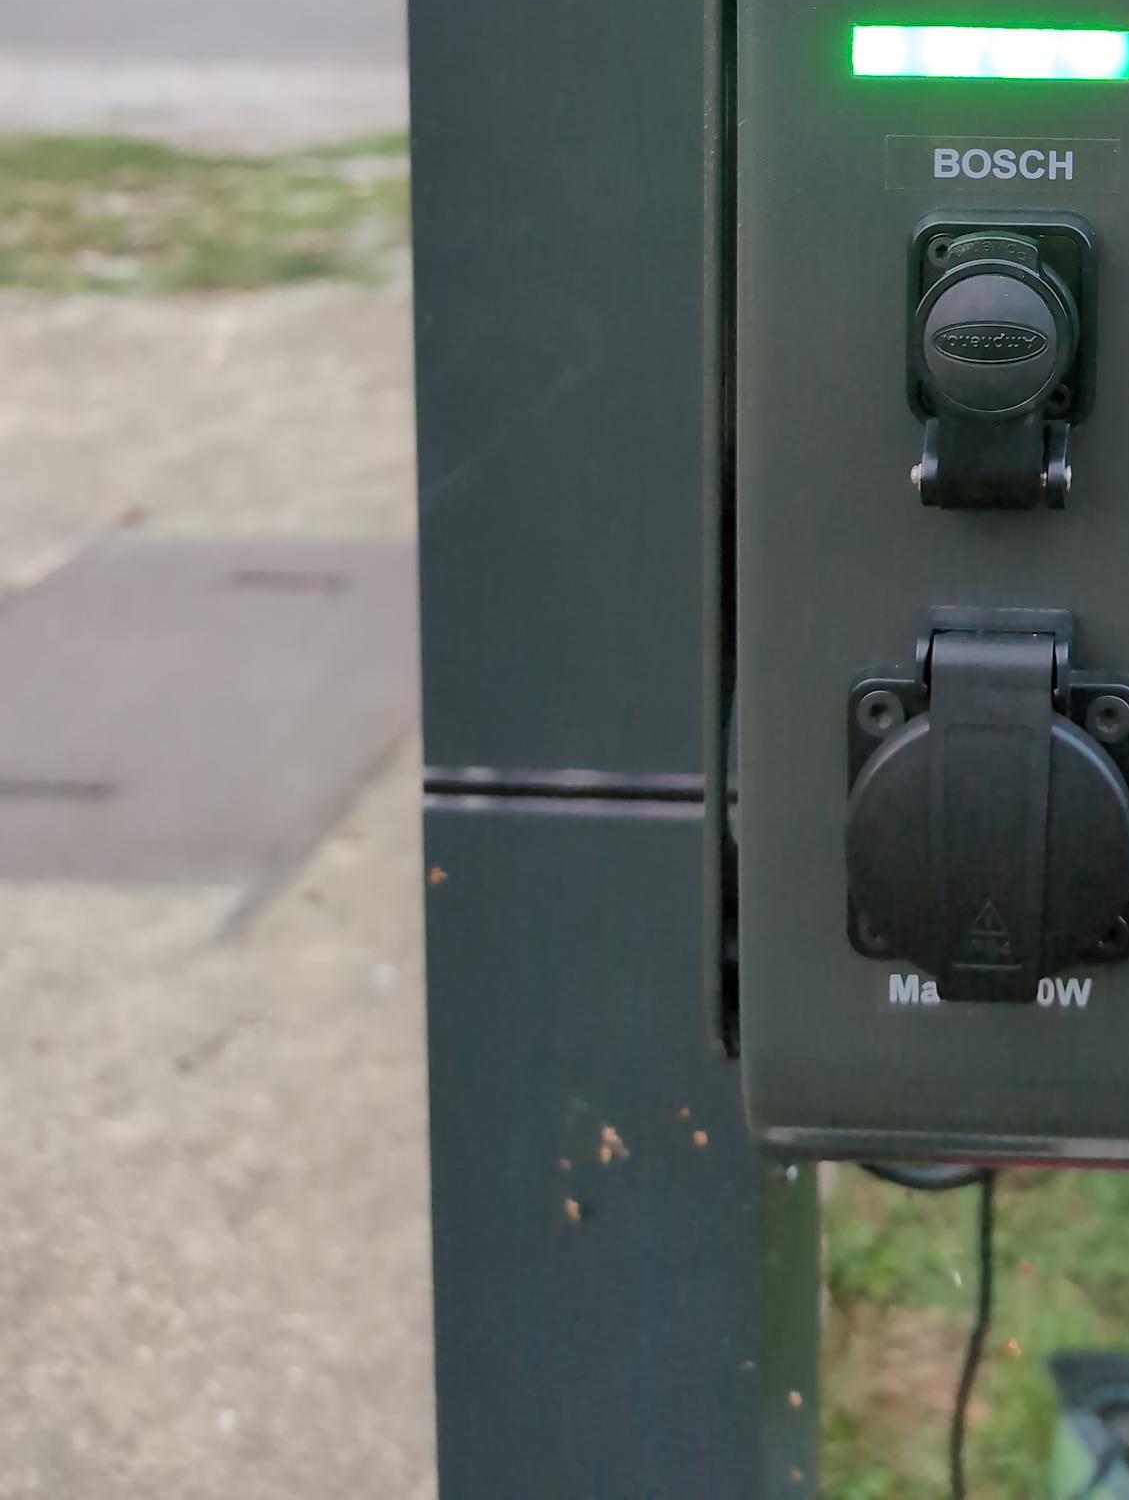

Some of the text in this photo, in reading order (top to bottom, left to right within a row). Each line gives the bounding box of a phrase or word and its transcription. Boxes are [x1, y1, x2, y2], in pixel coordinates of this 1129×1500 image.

[934, 148, 1074, 181] BOSCH
[889, 973, 1093, 1007] Ma 0W
